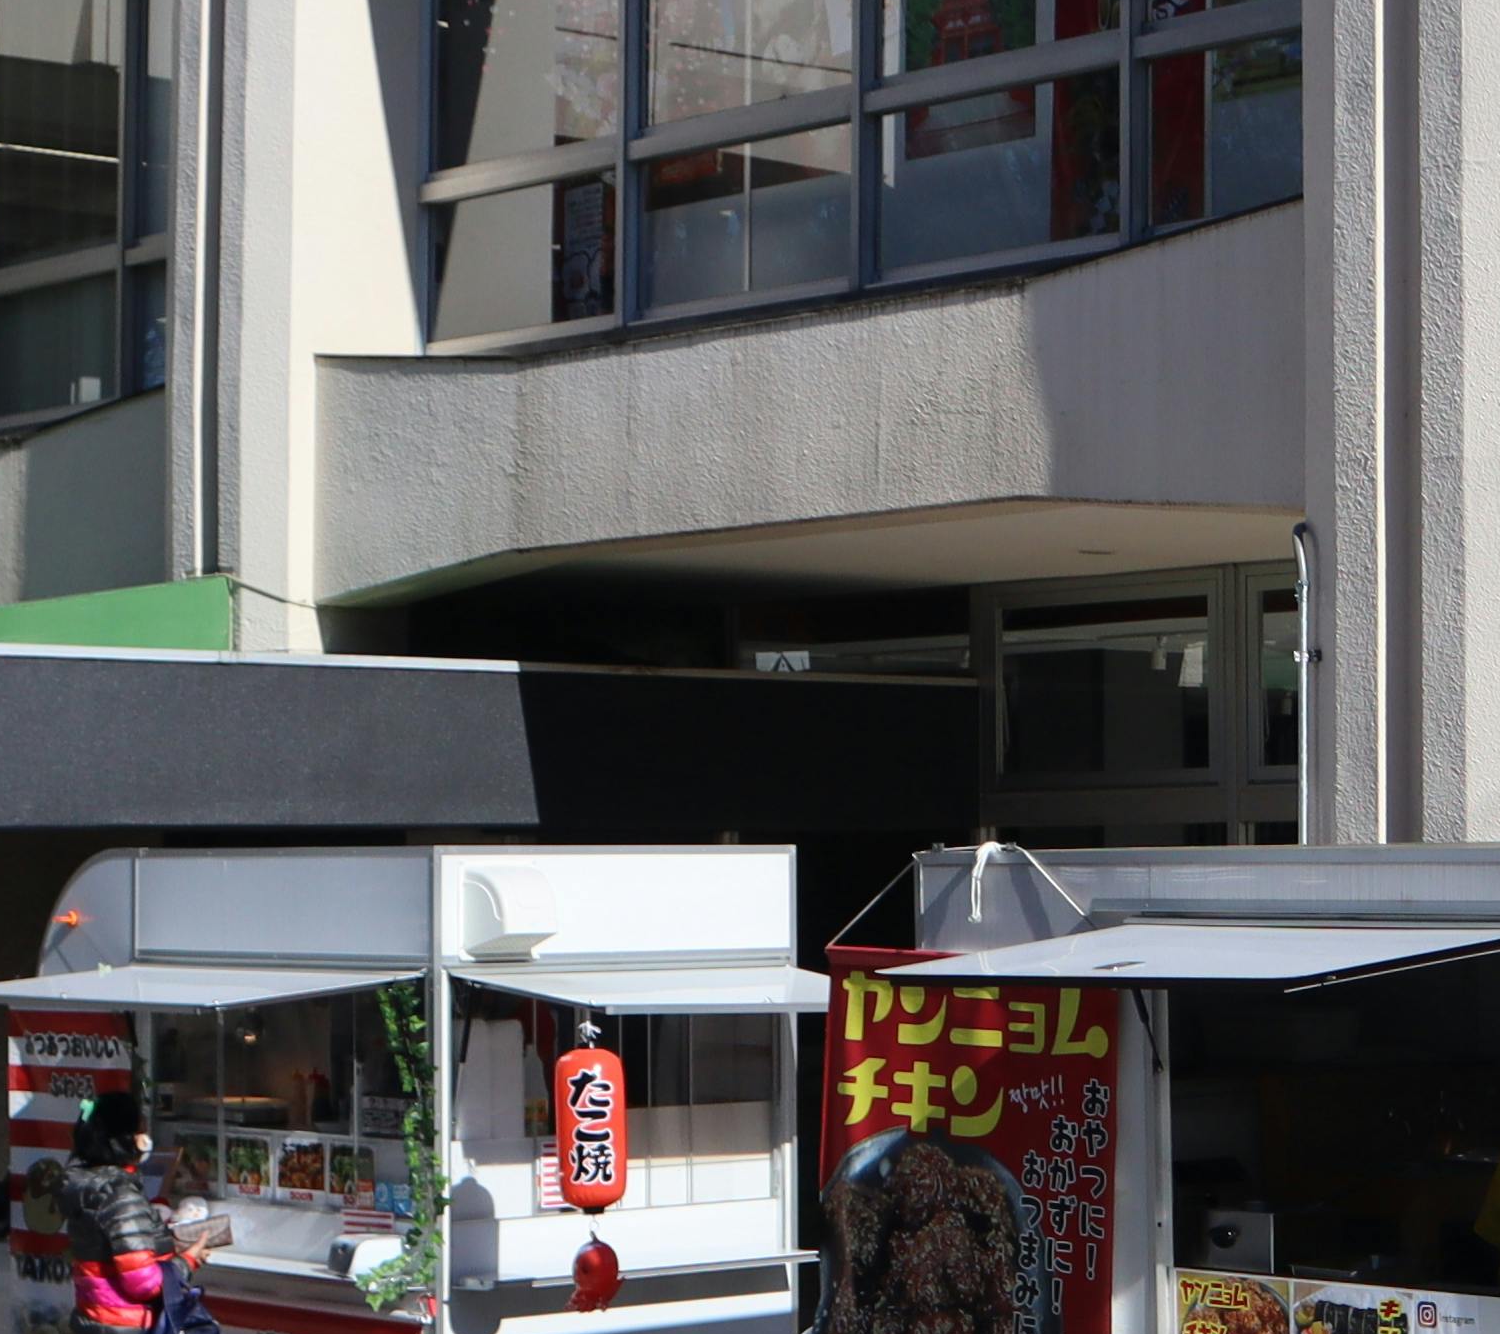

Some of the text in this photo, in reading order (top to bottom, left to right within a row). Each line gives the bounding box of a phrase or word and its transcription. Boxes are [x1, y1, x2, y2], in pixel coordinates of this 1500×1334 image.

[842, 971, 1109, 1059] ヤンニョム
[568, 1069, 614, 1183] たこ焼
[837, 1057, 1004, 1138] チキン
[1179, 1279, 1249, 1310] ヤンニョム
